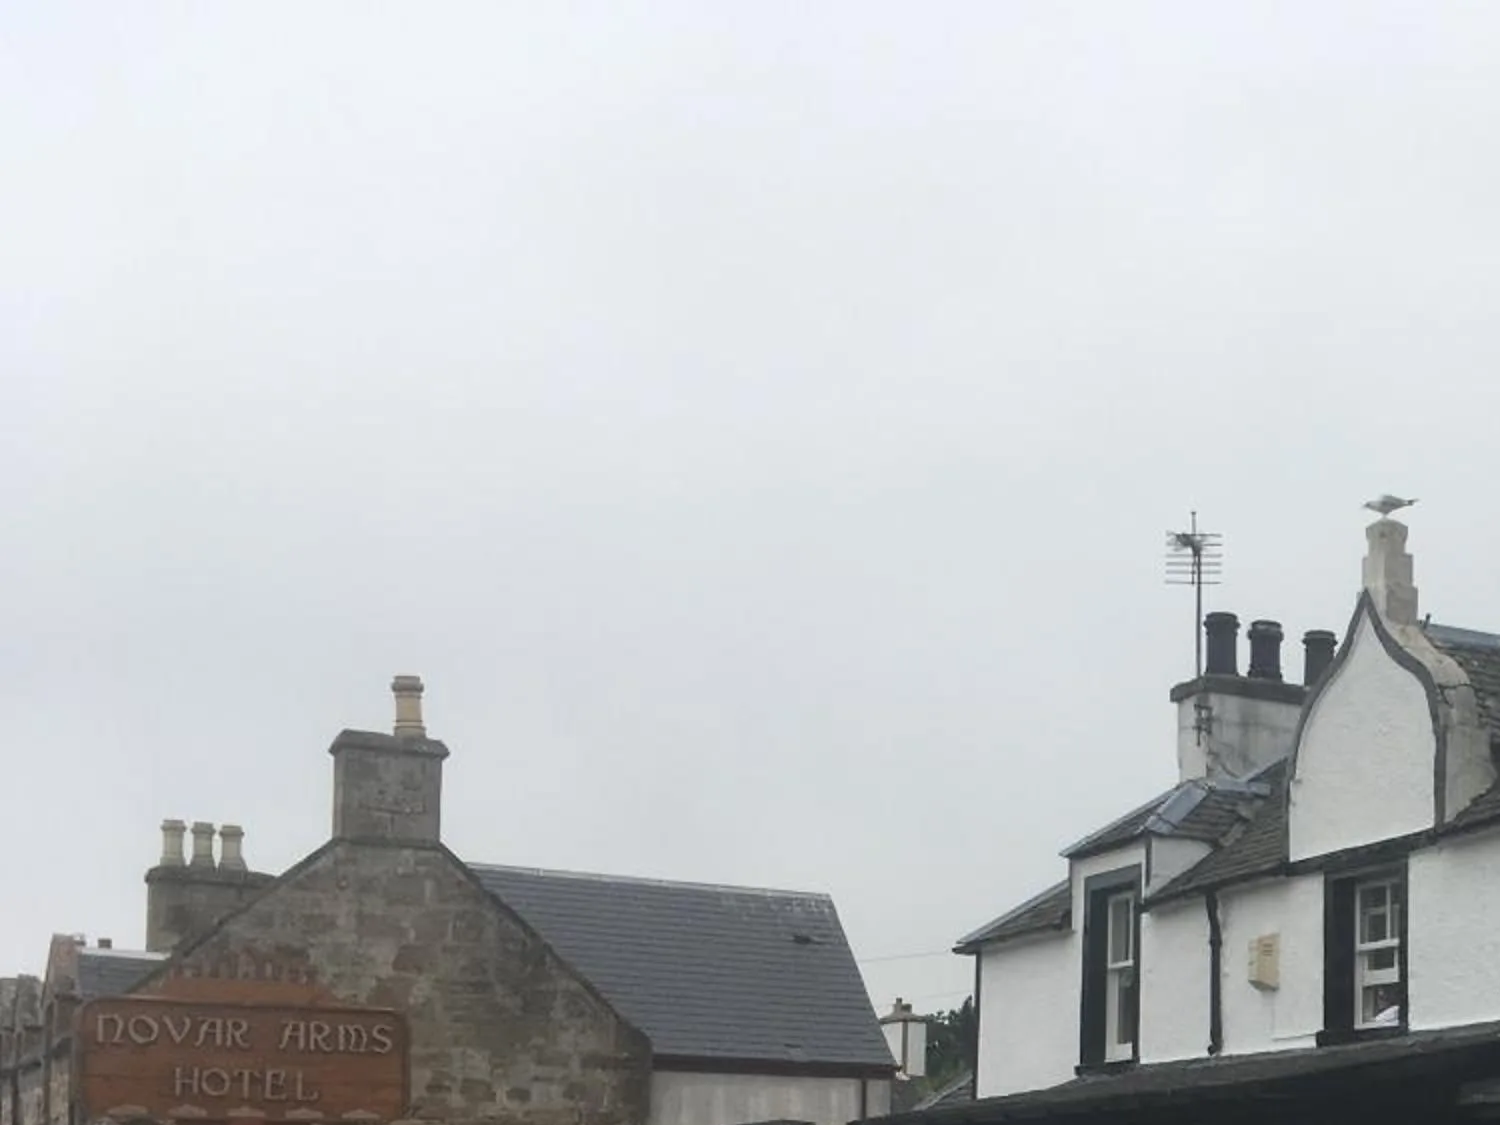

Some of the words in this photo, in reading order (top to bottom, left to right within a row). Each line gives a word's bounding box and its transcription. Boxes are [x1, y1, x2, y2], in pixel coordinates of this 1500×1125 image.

[97, 1014, 251, 1047] NOVAR
[279, 1021, 394, 1054] ARMS
[174, 1066, 320, 1101] HOTEL
